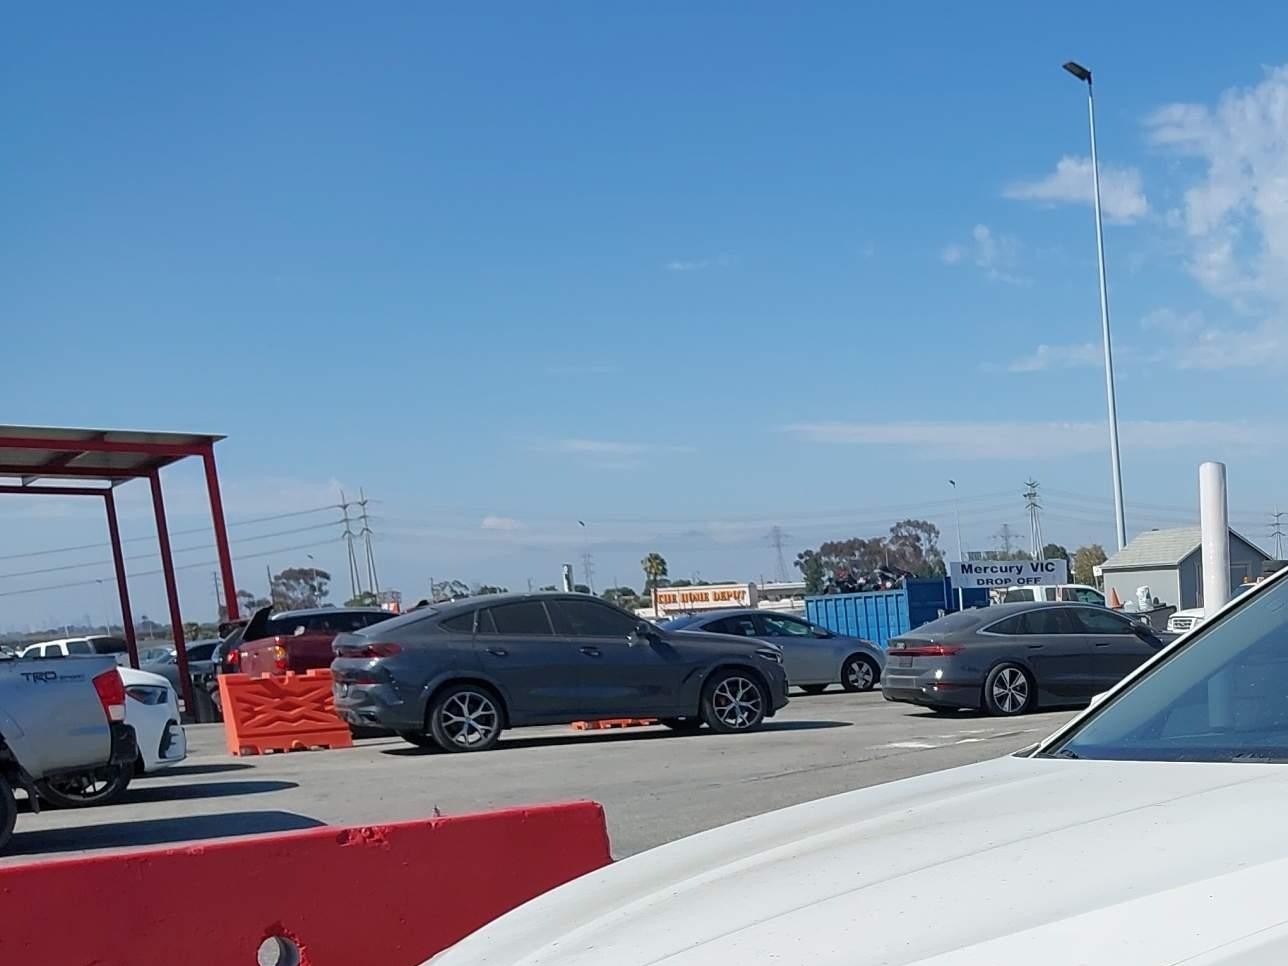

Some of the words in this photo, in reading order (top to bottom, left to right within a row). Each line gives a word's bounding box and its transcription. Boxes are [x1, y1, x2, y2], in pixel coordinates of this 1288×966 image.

[961, 563, 1023, 575] Mercury
[1030, 562, 1055, 572] VIC
[977, 578, 1012, 586] DROP
[1017, 577, 1041, 585] OFF
